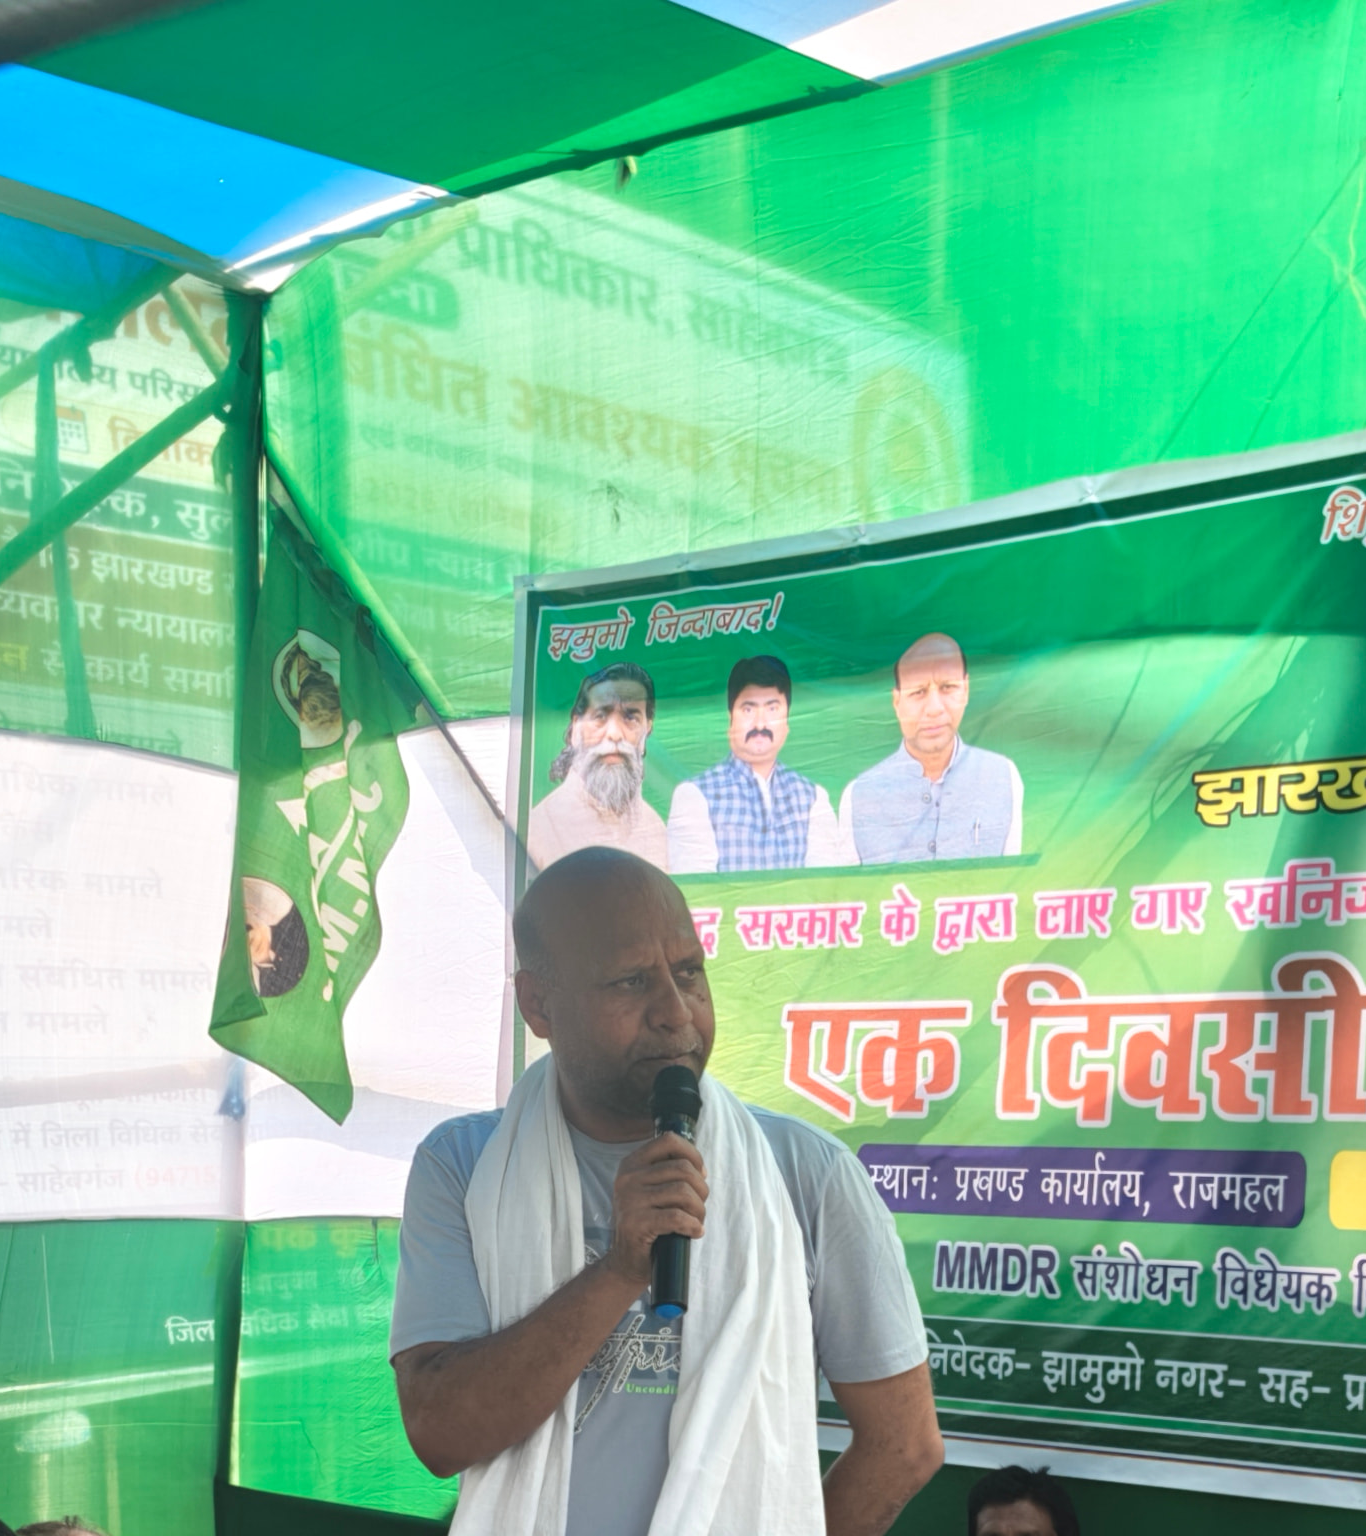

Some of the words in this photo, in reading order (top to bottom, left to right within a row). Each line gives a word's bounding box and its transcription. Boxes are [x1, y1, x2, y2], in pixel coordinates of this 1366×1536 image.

[88, 547, 214, 595] झारखण्ड
[645, 592, 785, 647] जिन्दाबाद!
[737, 902, 865, 951] सरकार
[880, 885, 920, 945] के
[934, 893, 1018, 954] द्वारा
[1036, 888, 1115, 942] लाए
[1133, 882, 1212, 934] गए
[781, 999, 972, 1124] एक
[40, 1117, 101, 1150] जिला
[954, 1163, 1029, 1207] प्रखण्ड
[1039, 1152, 1152, 1217] कार्यालय,
[1169, 1170, 1289, 1214] राजमहल
[934, 1240, 1060, 1299] MMDR
[1071, 1241, 1200, 1306] संशोधन
[1215, 1246, 1341, 1316] विधेयक
[1041, 1341, 1145, 1404] झामुमो
